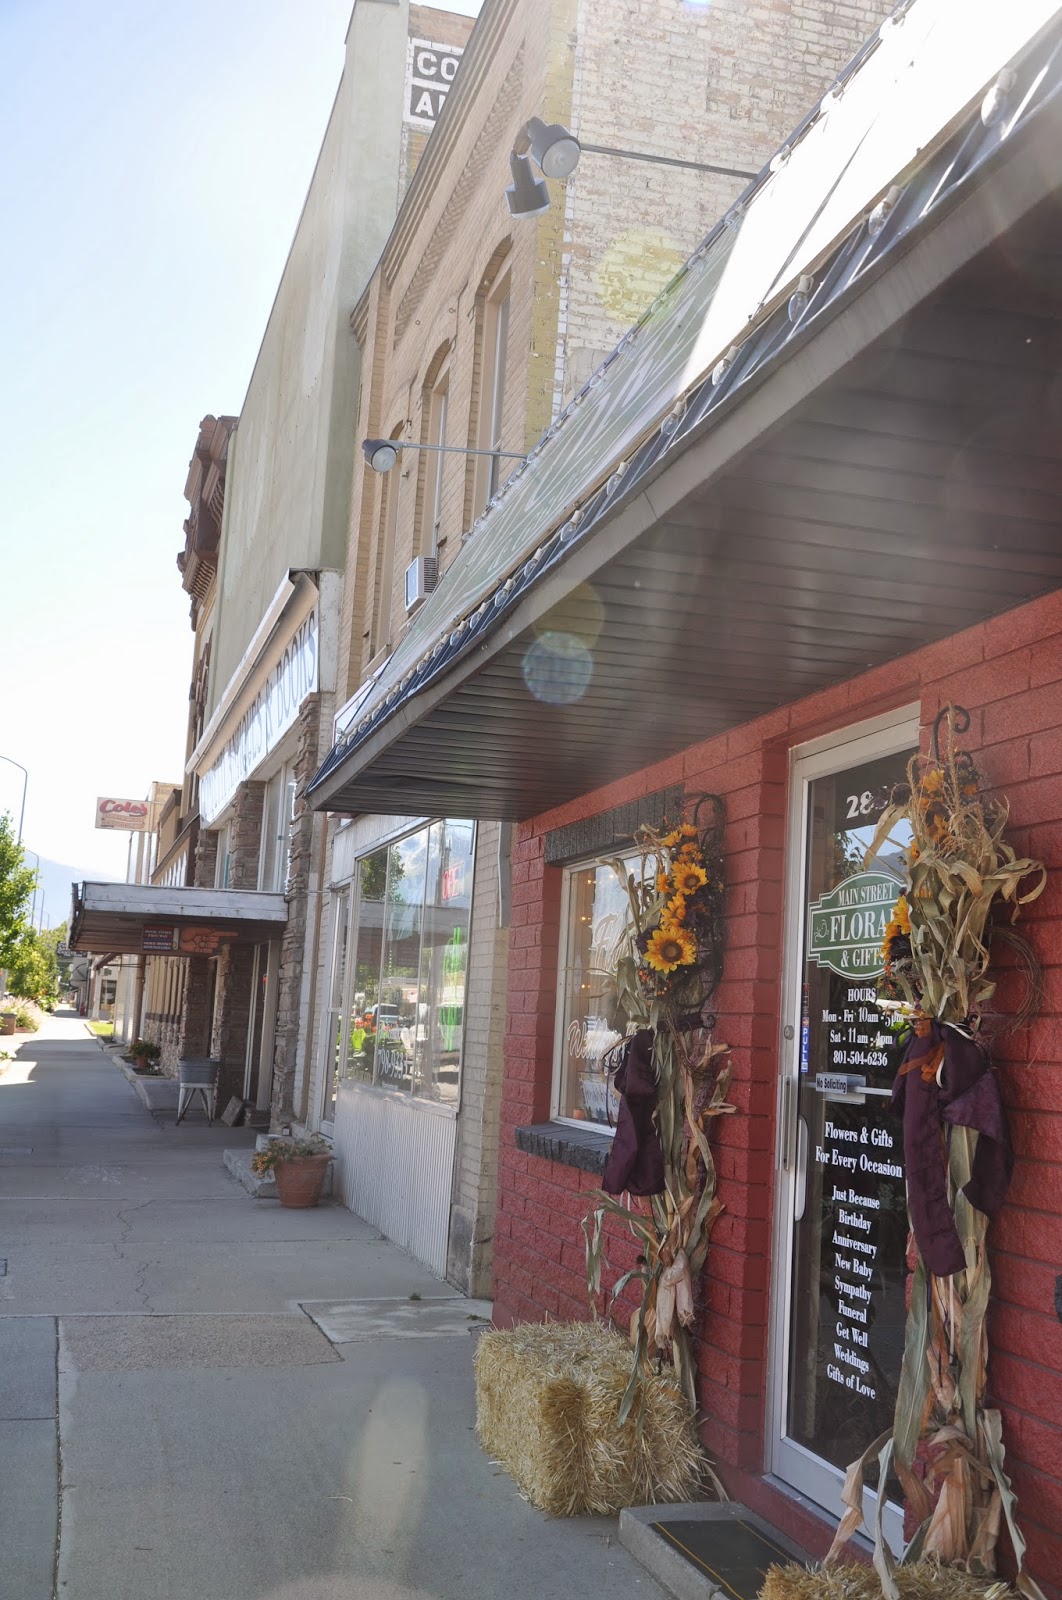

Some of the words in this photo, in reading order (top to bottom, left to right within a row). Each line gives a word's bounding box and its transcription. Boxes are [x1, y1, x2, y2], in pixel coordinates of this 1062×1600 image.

[276, 609, 316, 729] BOOKS
[838, 886, 859, 907] MAIN
[860, 881, 895, 902] STREET
[840, 951, 850, 968] &
[847, 988, 877, 1001] HOURS
[822, 1009, 837, 1022] Mon
[858, 1007, 879, 1022] 10am
[801, 1027, 809, 1062] PULL
[830, 1029, 841, 1043] Sat
[848, 1028, 869, 1044] 11am
[833, 1050, 888, 1067] 801-504-6236
[816, 1078, 823, 1088] No
[824, 1078, 847, 1093] Soliciting
[825, 1121, 858, 1142] Flowers
[860, 1126, 869, 1144] &
[871, 1128, 893, 1148] Gifts
[815, 1145, 830, 1163] For
[831, 1148, 857, 1173] Every
[860, 1154, 903, 1178] Occasion
[831, 1185, 847, 1201] Just
[848, 1188, 880, 1209] Because
[838, 1208, 872, 1234] Birthday
[832, 1229, 877, 1258] Anniversary
[835, 1252, 851, 1271] New
[853, 1258, 873, 1281] Baby
[835, 1276, 872, 1304] Sympathy
[838, 1299, 867, 1323] Funeral
[836, 1321, 850, 1340] Get
[851, 1327, 869, 1348] Well
[834, 1342, 870, 1374] Weddings
[827, 1363, 844, 1384] Gifts
[846, 1375, 856, 1390] of
[856, 1376, 876, 1400] Love
